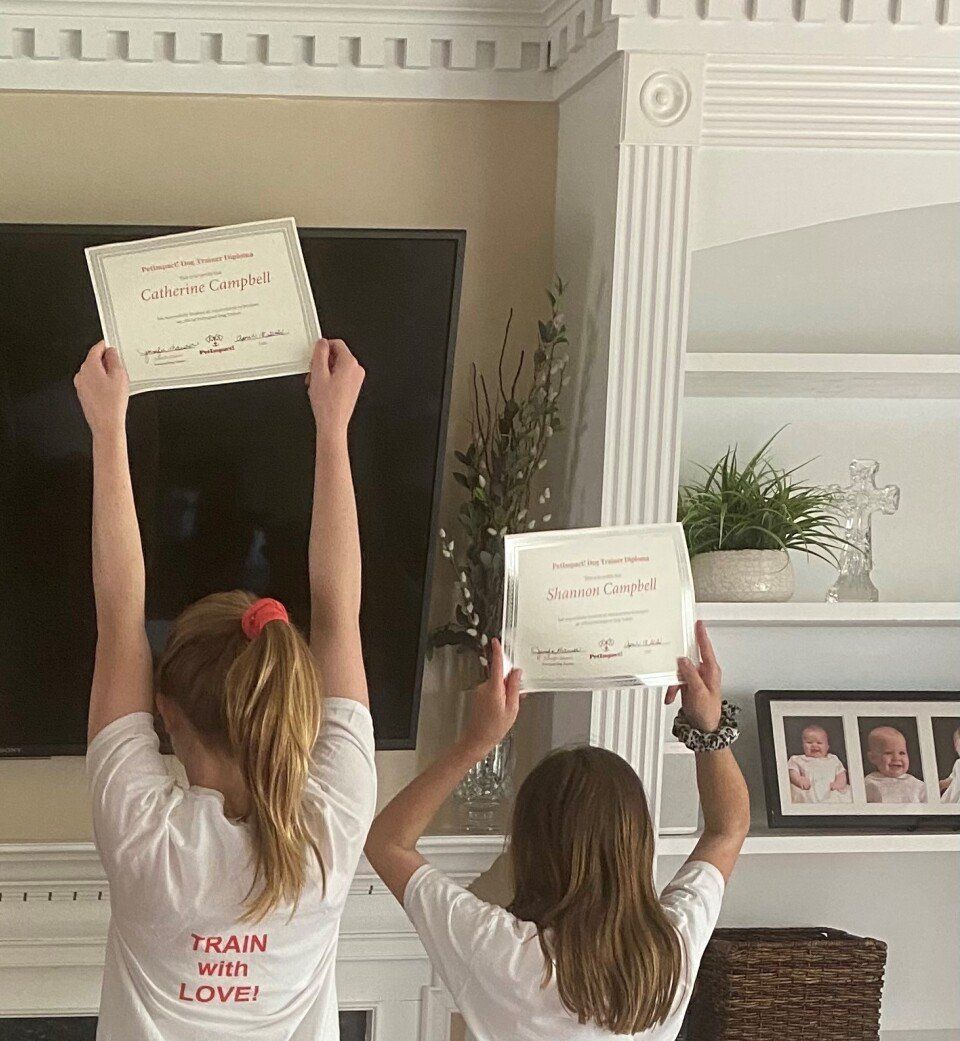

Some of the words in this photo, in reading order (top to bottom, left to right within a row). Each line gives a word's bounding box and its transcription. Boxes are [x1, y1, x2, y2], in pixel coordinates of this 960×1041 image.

[141, 283, 205, 301] Catherine
[209, 271, 271, 292] Campbell
[546, 586, 600, 601] Shannon
[603, 577, 657, 596] Campbell
[191, 933, 268, 953] TRAIN
[198, 960, 248, 977] with
[178, 983, 259, 1003] LOVE!
